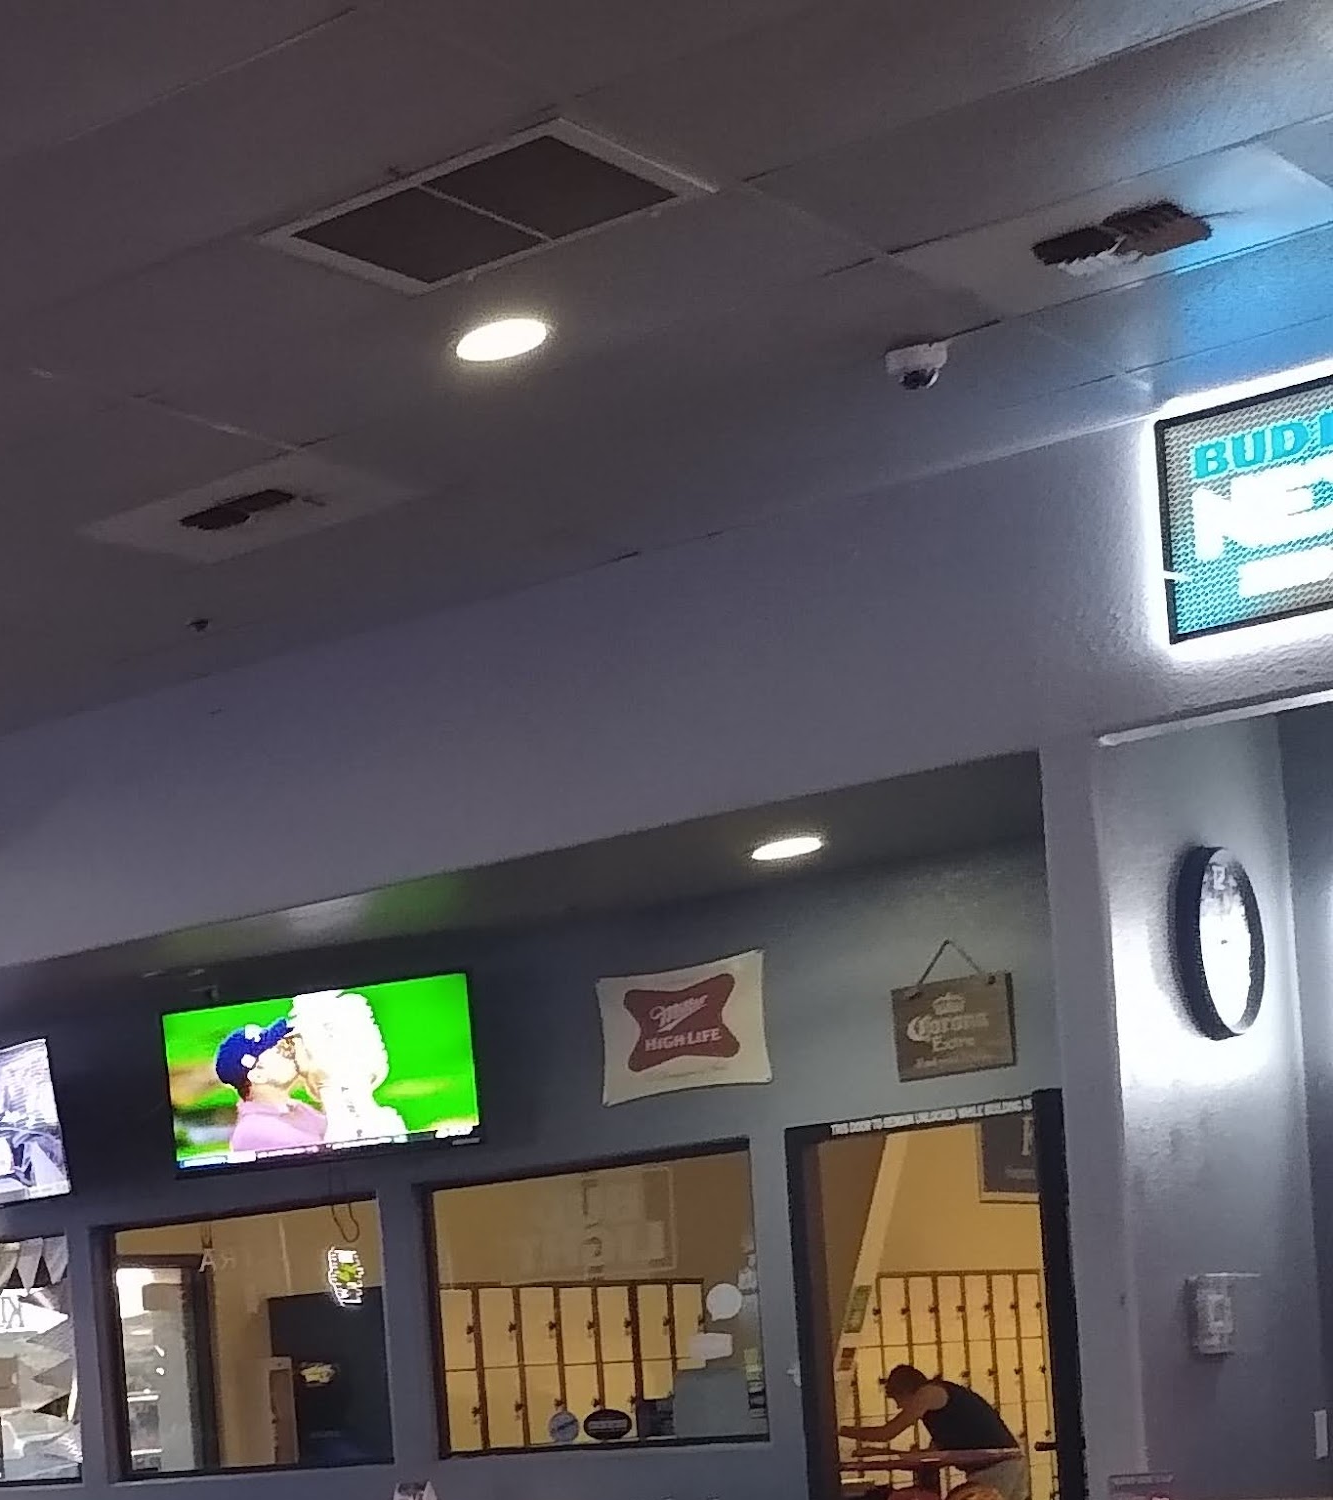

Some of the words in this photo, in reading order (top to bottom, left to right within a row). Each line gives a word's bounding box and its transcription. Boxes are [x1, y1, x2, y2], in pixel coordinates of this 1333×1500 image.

[1194, 421, 1311, 480] BUD
[644, 1033, 684, 1051] HIGH
[687, 1027, 723, 1045] LIFE
